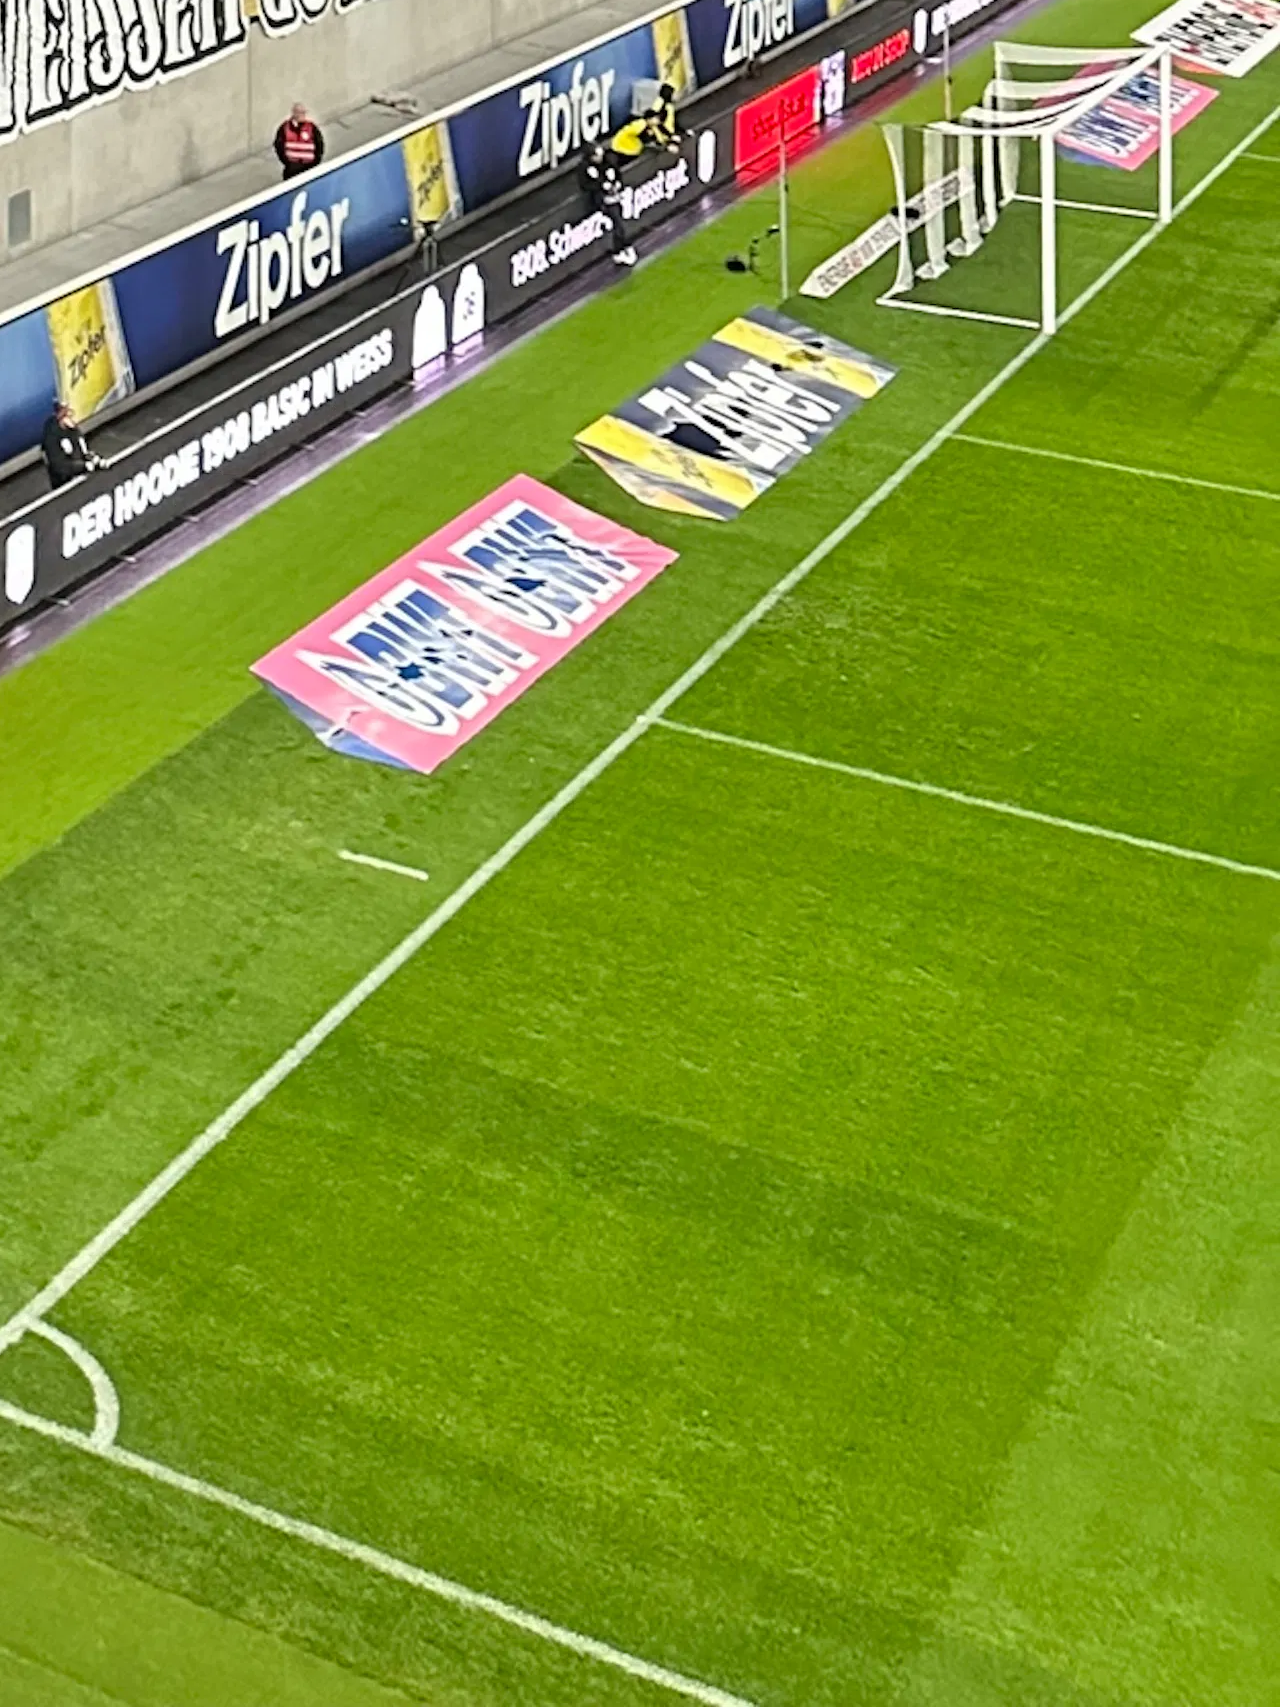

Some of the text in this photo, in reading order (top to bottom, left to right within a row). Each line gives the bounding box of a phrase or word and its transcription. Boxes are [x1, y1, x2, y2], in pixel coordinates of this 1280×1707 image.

[518, 61, 615, 177] Zipfer
[215, 190, 350, 338] Zipfer
[62, 328, 394, 560] DER HOODIE 1908 BASIC IN WEISS
[638, 358, 842, 469] Zipfer
